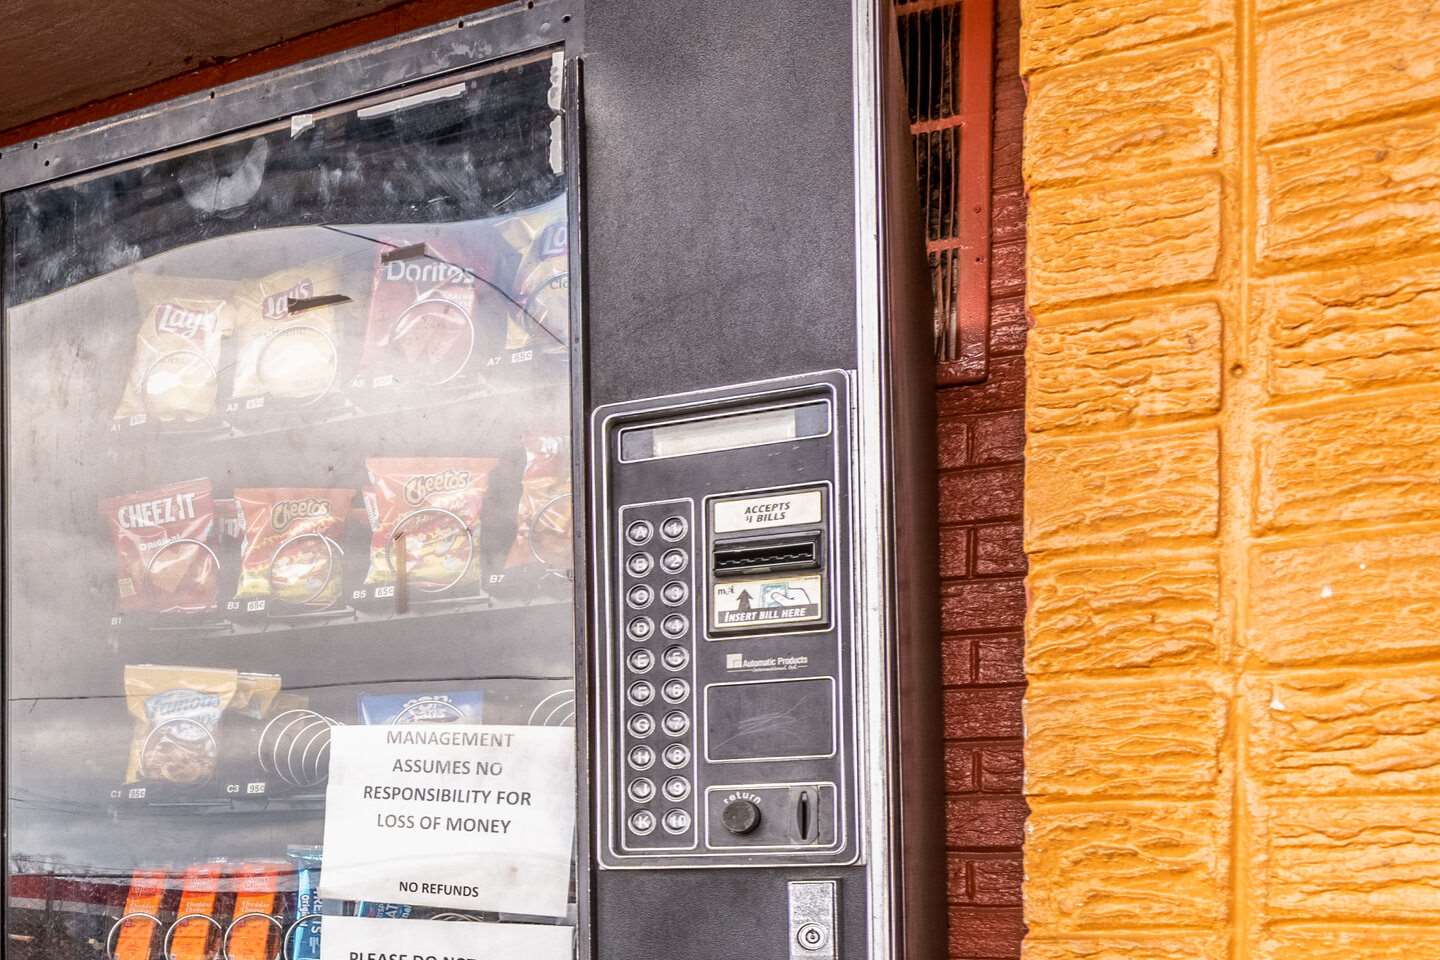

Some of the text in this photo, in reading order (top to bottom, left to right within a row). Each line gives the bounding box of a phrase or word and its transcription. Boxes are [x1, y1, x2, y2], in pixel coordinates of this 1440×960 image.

[386, 260, 475, 283] Doritos
[404, 469, 471, 506] Cheetos
[271, 500, 331, 532] Cheetos
[744, 501, 791, 515] ACCEPTS
[756, 511, 786, 523] BILLS
[724, 607, 807, 622] INSERT BILL HERE
[743, 656, 808, 668] Automatic Products
[386, 730, 514, 748] MANAGEMENT
[392, 758, 503, 776] ASSUMES NO
[363, 785, 532, 806] RESPONSIBILITY FOR
[723, 791, 762, 805] return
[376, 813, 512, 834] LOSS OF MONEY
[399, 881, 480, 897] NO REFUNDS
